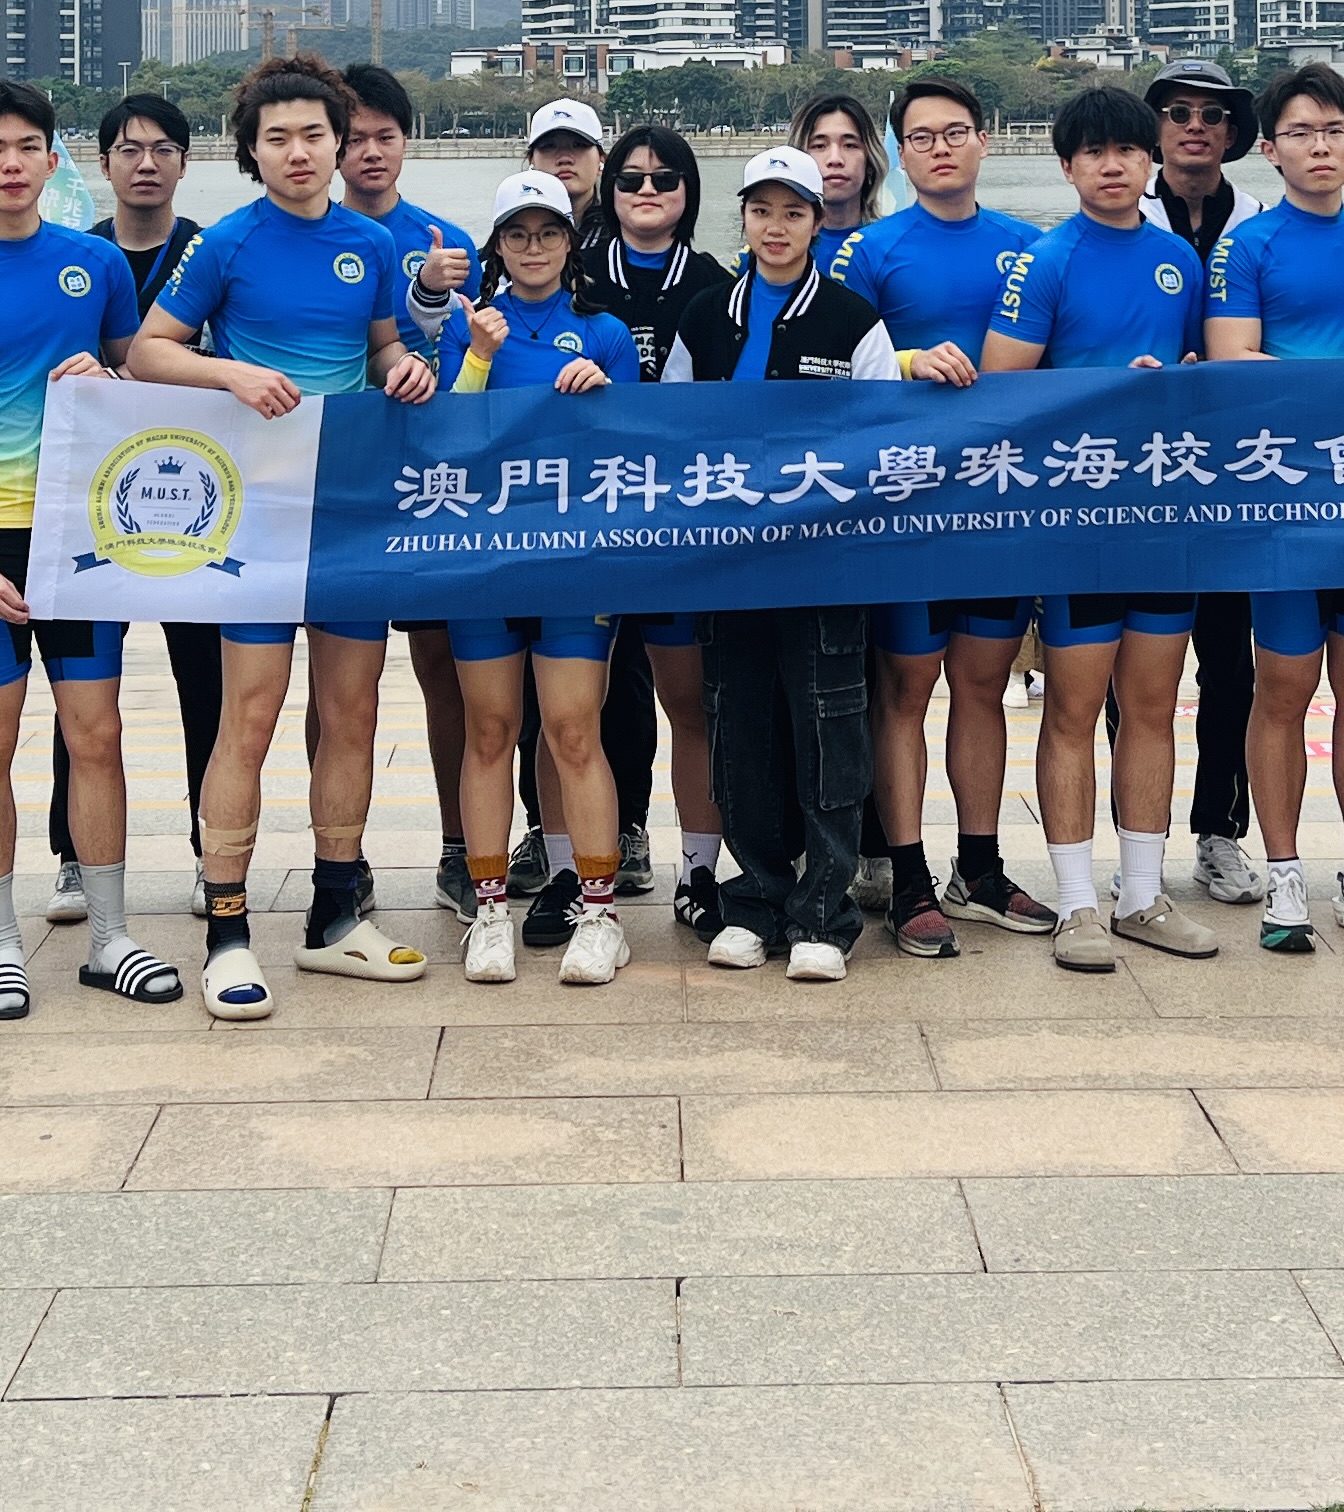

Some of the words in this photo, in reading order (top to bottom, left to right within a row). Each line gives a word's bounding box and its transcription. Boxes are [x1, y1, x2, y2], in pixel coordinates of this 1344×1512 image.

[1000, 252, 1035, 323] MUST
[1209, 238, 1234, 303] MUST
[385, 531, 482, 553] ZHUHAI
[487, 529, 587, 551] ALUMNI
[591, 525, 755, 549] ASSOCIATION
[761, 523, 795, 543] OF
[797, 515, 886, 541] MACAO
[892, 508, 1037, 534] UNIVERSITY
[1040, 507, 1073, 528] OF
[1077, 504, 1179, 526] SCIENCE
[1183, 502, 1233, 524] AND
